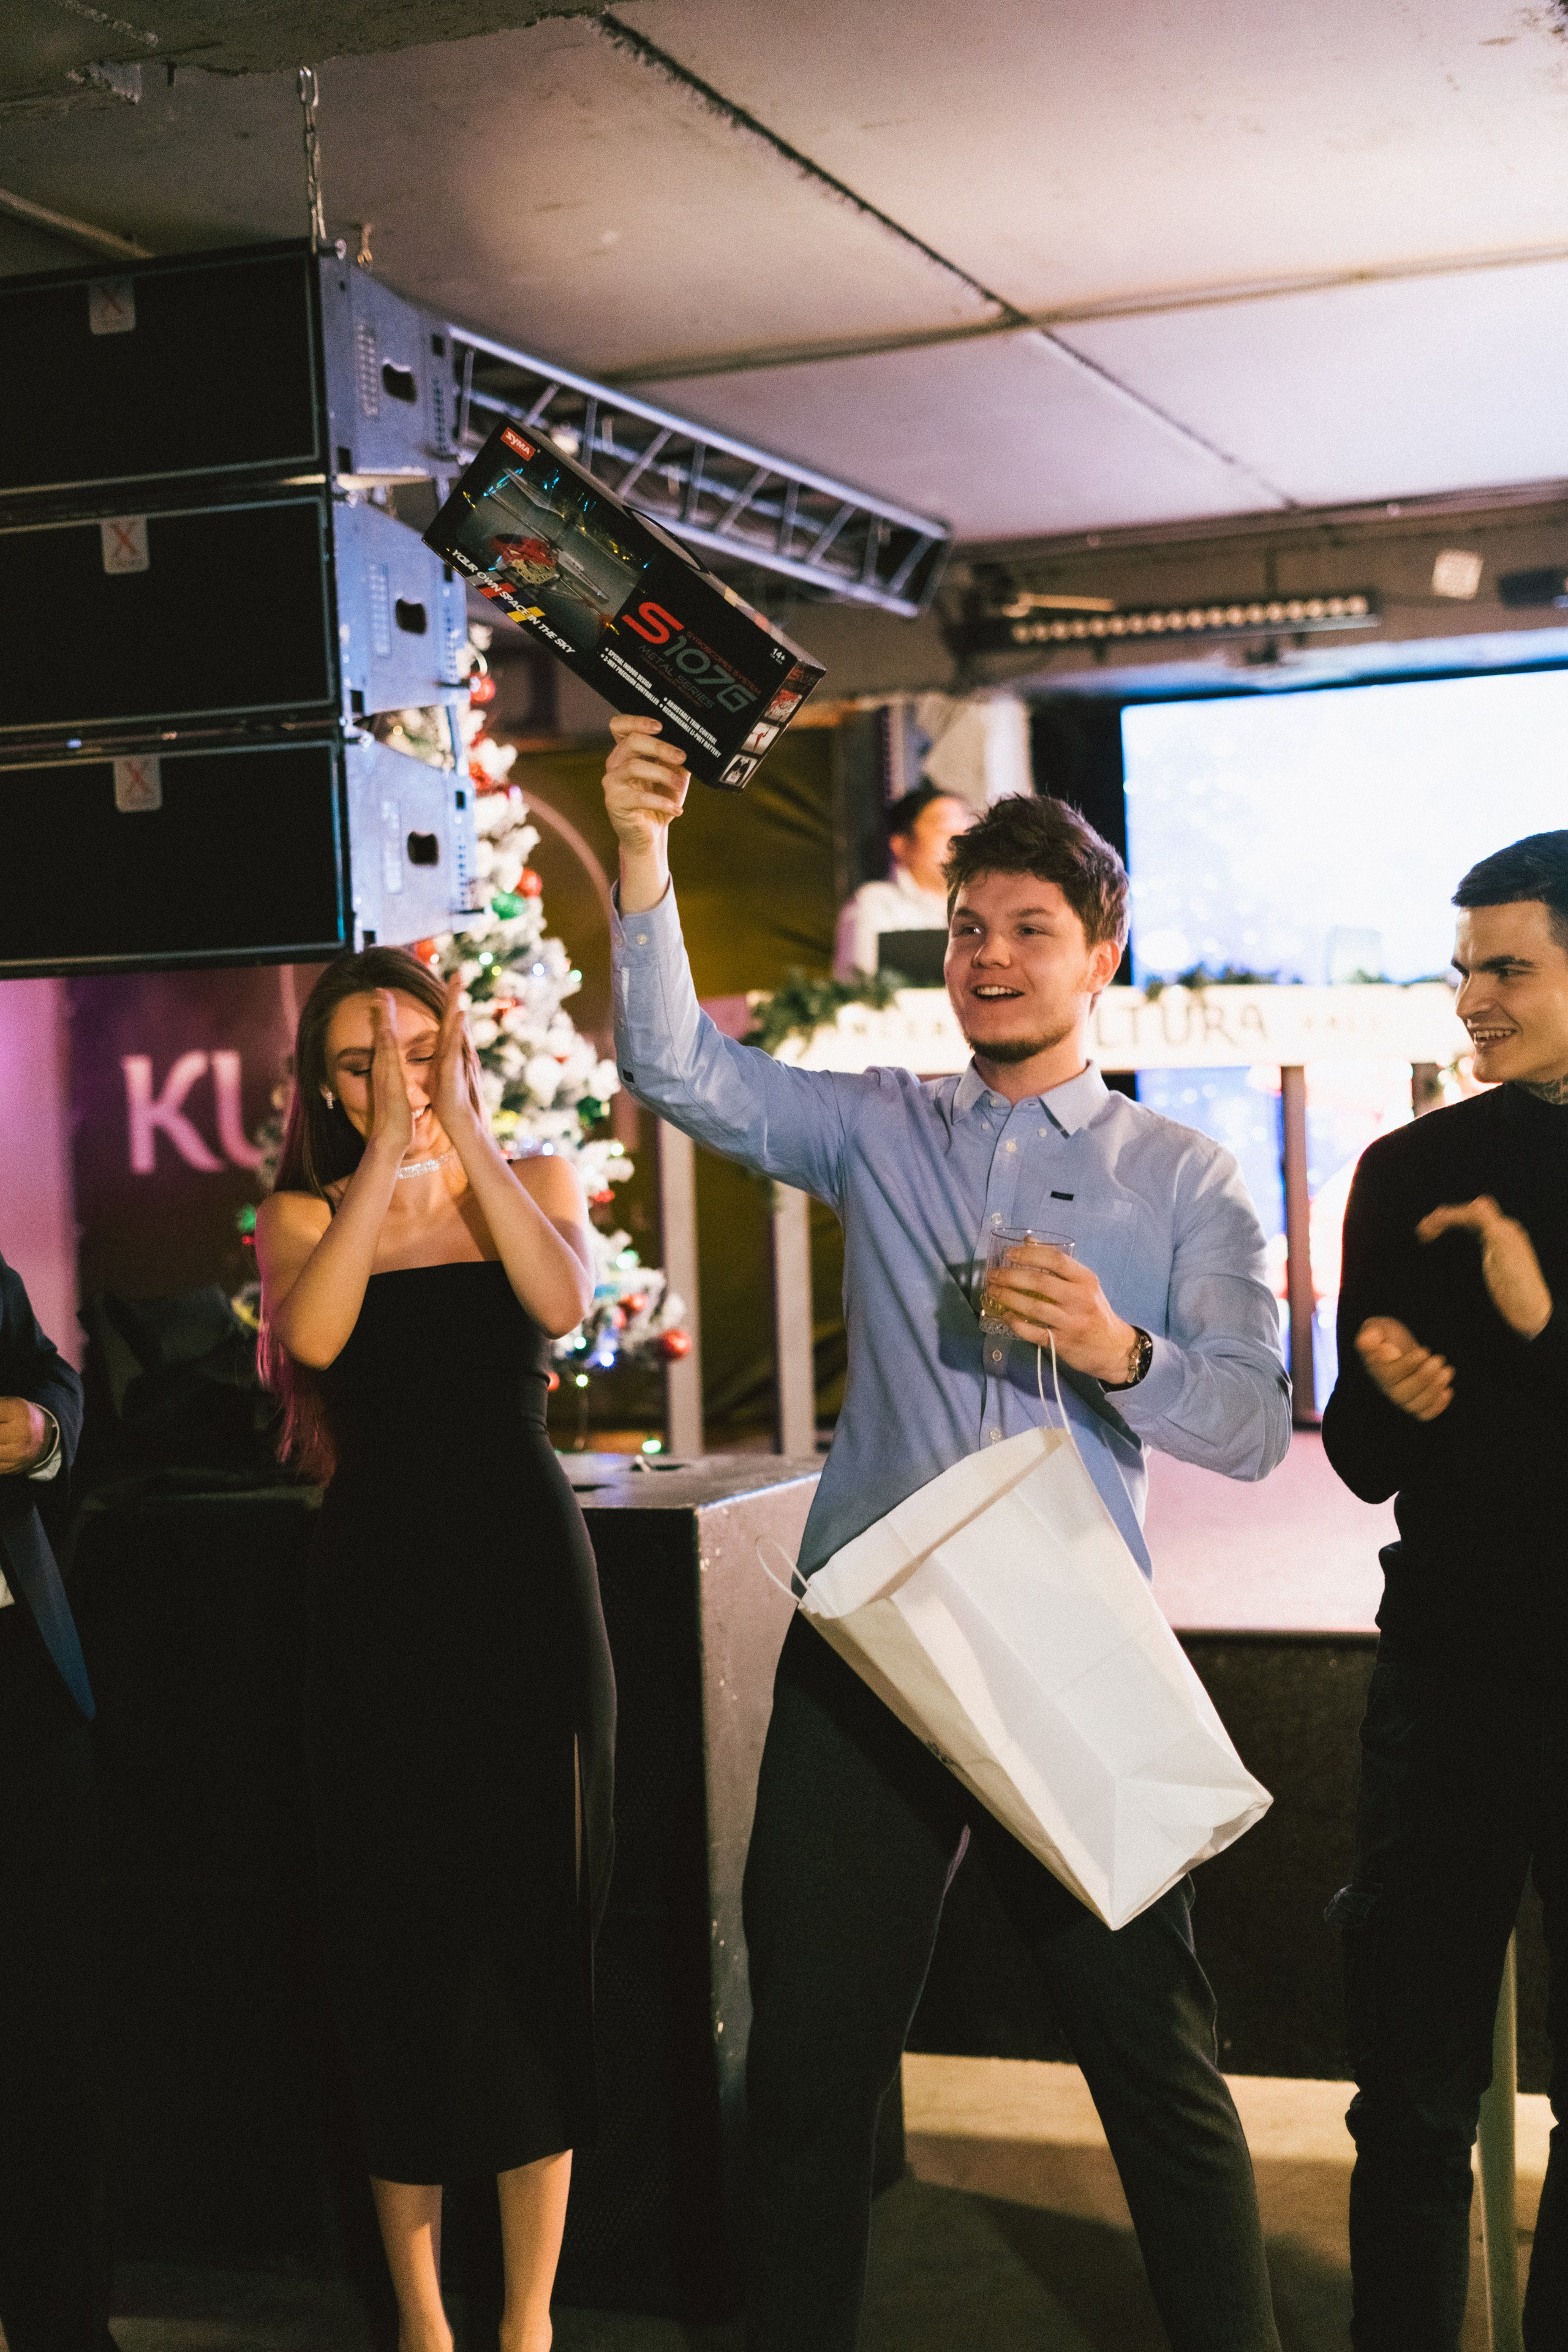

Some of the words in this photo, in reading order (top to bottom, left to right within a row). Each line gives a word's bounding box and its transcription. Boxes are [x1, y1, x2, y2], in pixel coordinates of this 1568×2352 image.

[451, 548, 478, 573] YOUR
[476, 571, 502, 592] OWN
[499, 590, 529, 616] SPACE
[526, 612, 540, 625] IN
[538, 623, 557, 639] THE
[554, 638, 575, 653] SKY
[607, 649, 624, 666] SPECIAL
[622, 662, 639, 678] INDOOR
[636, 673, 652, 689] DESIGN
[638, 644, 674, 676] METAL
[674, 674, 714, 708] SERIES
[772, 647, 785, 660] 14+
[602, 655, 618, 669] 3-WAY
[614, 665, 637, 686] PRECISION
[634, 682, 660, 706] CONTROLLER
[732, 669, 761, 694] SYSTEM
[662, 705, 692, 733] RECHARGEABLE
[688, 728, 706, 744] LI-POLY
[702, 740, 722, 758] BATTERY
[666, 699, 691, 722] ADJUSTABLE
[688, 717, 701, 731] TRIM
[698, 726, 717, 745] CONTROL
[1095, 1003, 1270, 1049] LTURA
